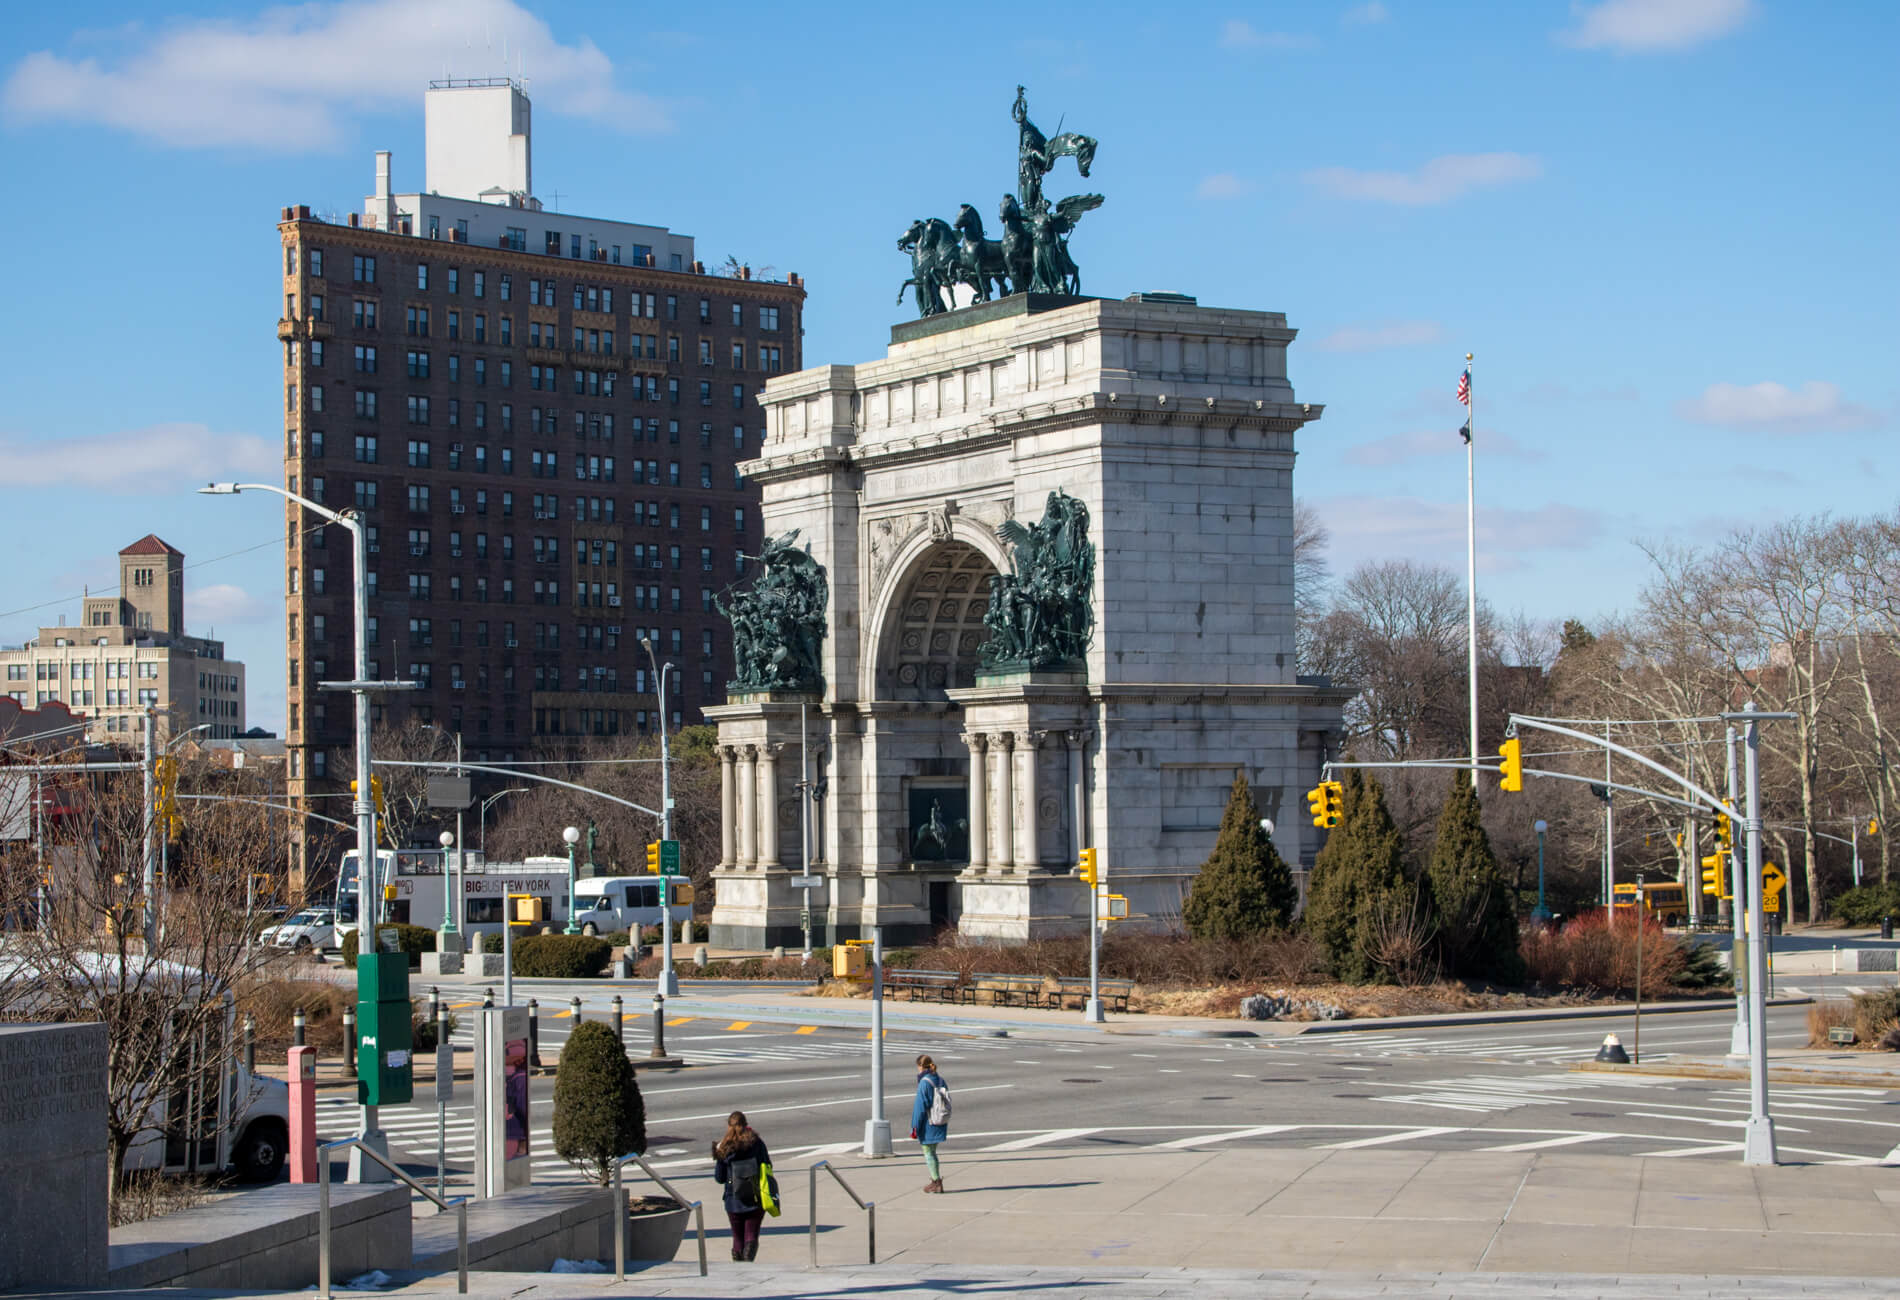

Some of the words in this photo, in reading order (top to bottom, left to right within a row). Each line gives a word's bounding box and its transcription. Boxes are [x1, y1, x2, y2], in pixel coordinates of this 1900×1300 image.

[501, 880, 523, 892] NEW
[525, 879, 551, 891] YORK
[1764, 896, 1778, 905] 20
